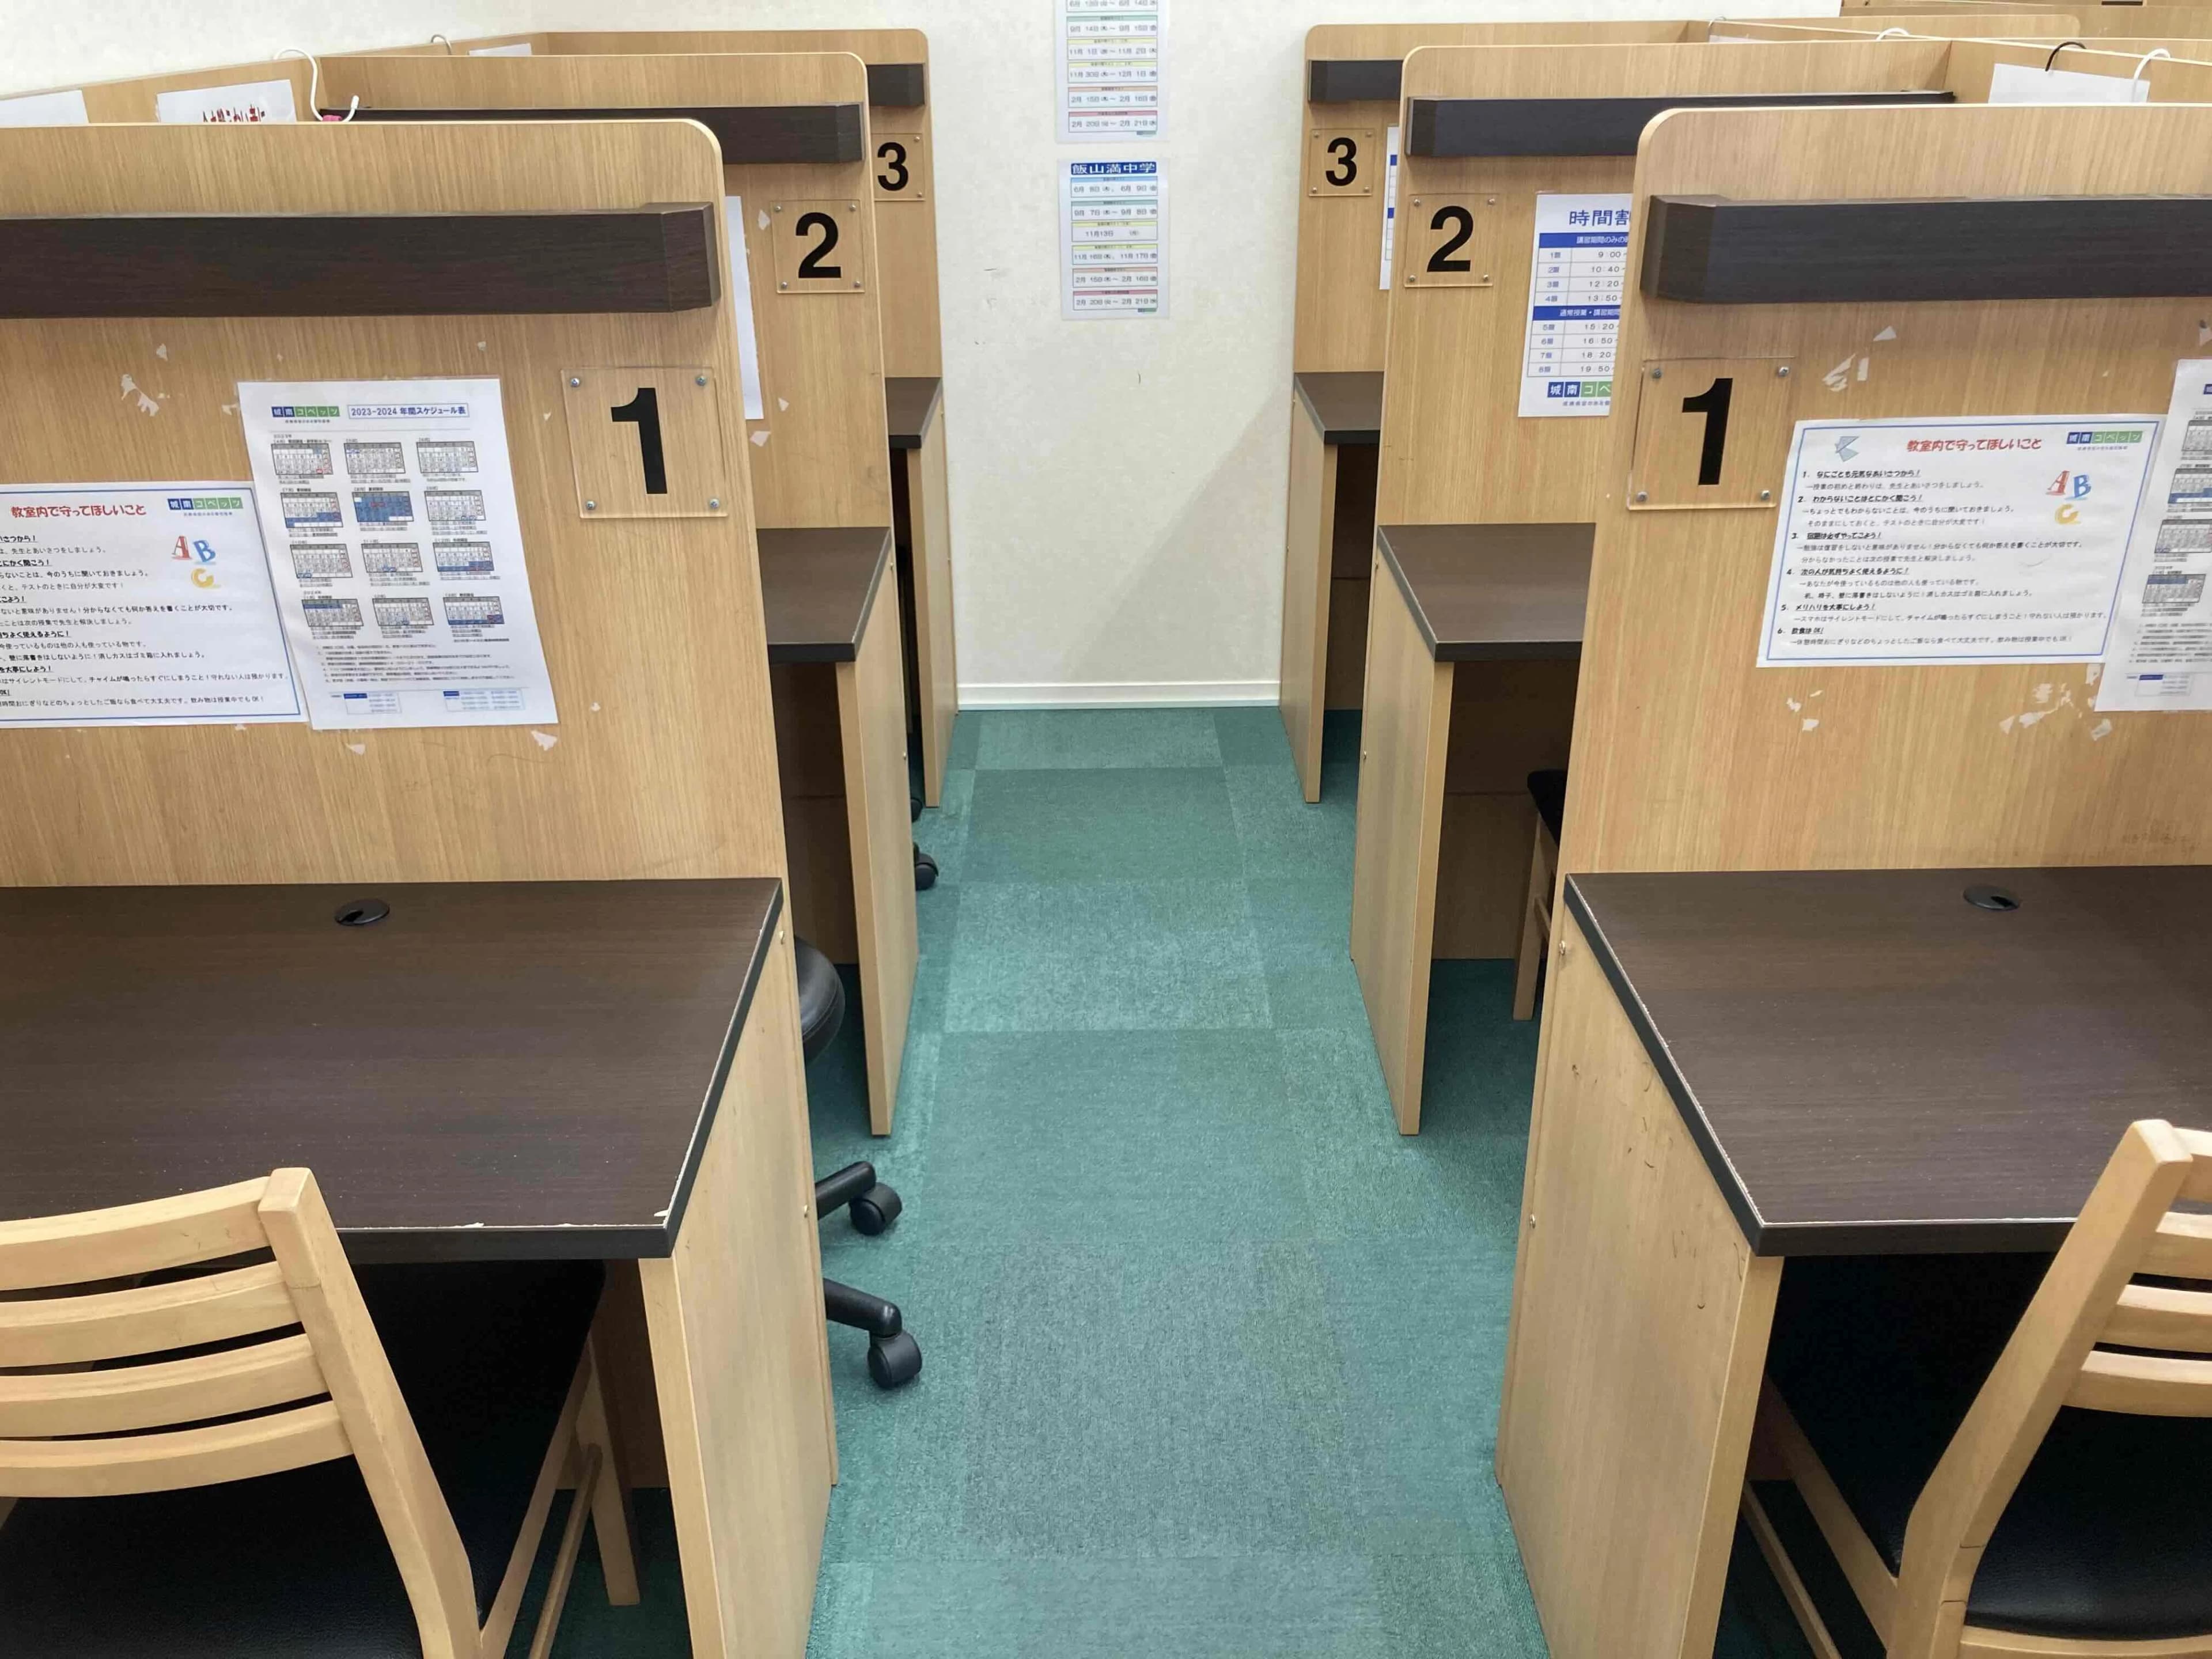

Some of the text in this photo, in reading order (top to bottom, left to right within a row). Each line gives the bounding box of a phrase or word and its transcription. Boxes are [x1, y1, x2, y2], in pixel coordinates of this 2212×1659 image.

[877, 142, 908, 191] 3
[1072, 163, 1155, 174] 飯山満中学
[1326, 137, 1357, 186] 3
[796, 212, 842, 278] 2
[1427, 206, 1474, 272] 2
[351, 407, 397, 416] 2023-2024
[1682, 378, 1733, 485] 1
[611, 387, 668, 494] 1
[1907, 438, 2042, 453] 教室内で守ってほしいこと
[11, 505, 146, 518] 教室内で守ってほしいこと
